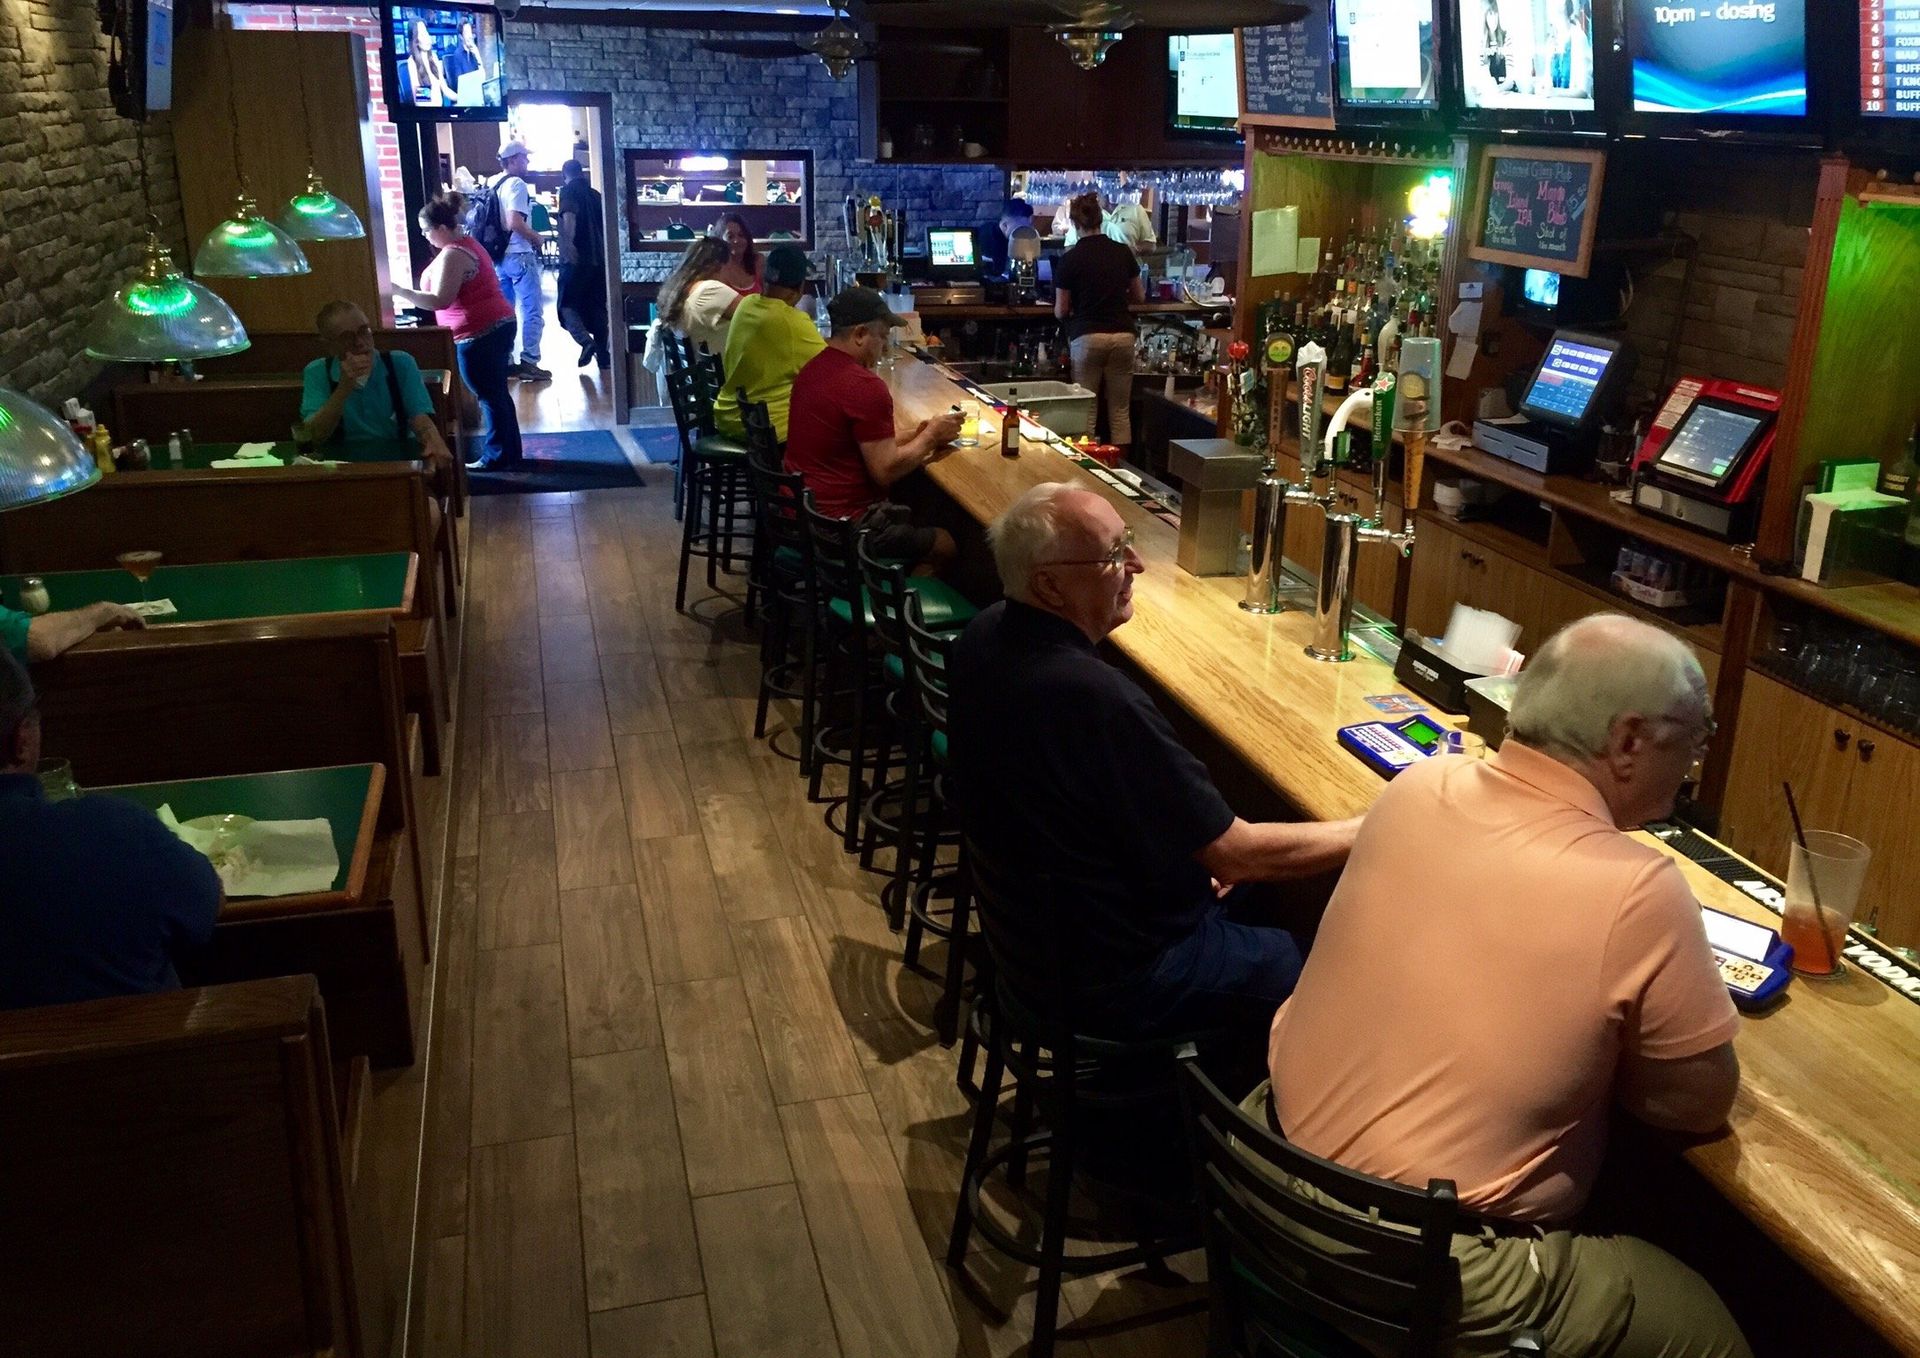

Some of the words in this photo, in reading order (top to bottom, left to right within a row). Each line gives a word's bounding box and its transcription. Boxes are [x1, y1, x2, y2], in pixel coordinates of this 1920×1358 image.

[1871, 0, 1879, 8] 2
[1654, 6, 1695, 26] 10pm
[1715, 1, 1775, 22] closing
[1871, 10, 1879, 20] 3
[1871, 24, 1879, 33] 4
[1871, 37, 1879, 47] 5
[1871, 50, 1879, 59] 6
[1871, 63, 1880, 73] 7
[1871, 76, 1880, 86] 8
[1872, 89, 1880, 98] 9
[1866, 101, 1880, 111] 10
[1514, 209, 1532, 226] IPA
[1486, 217, 1507, 234] Beer
[1302, 403, 1312, 440] LIGHT
[1373, 400, 1383, 441] Heineken
